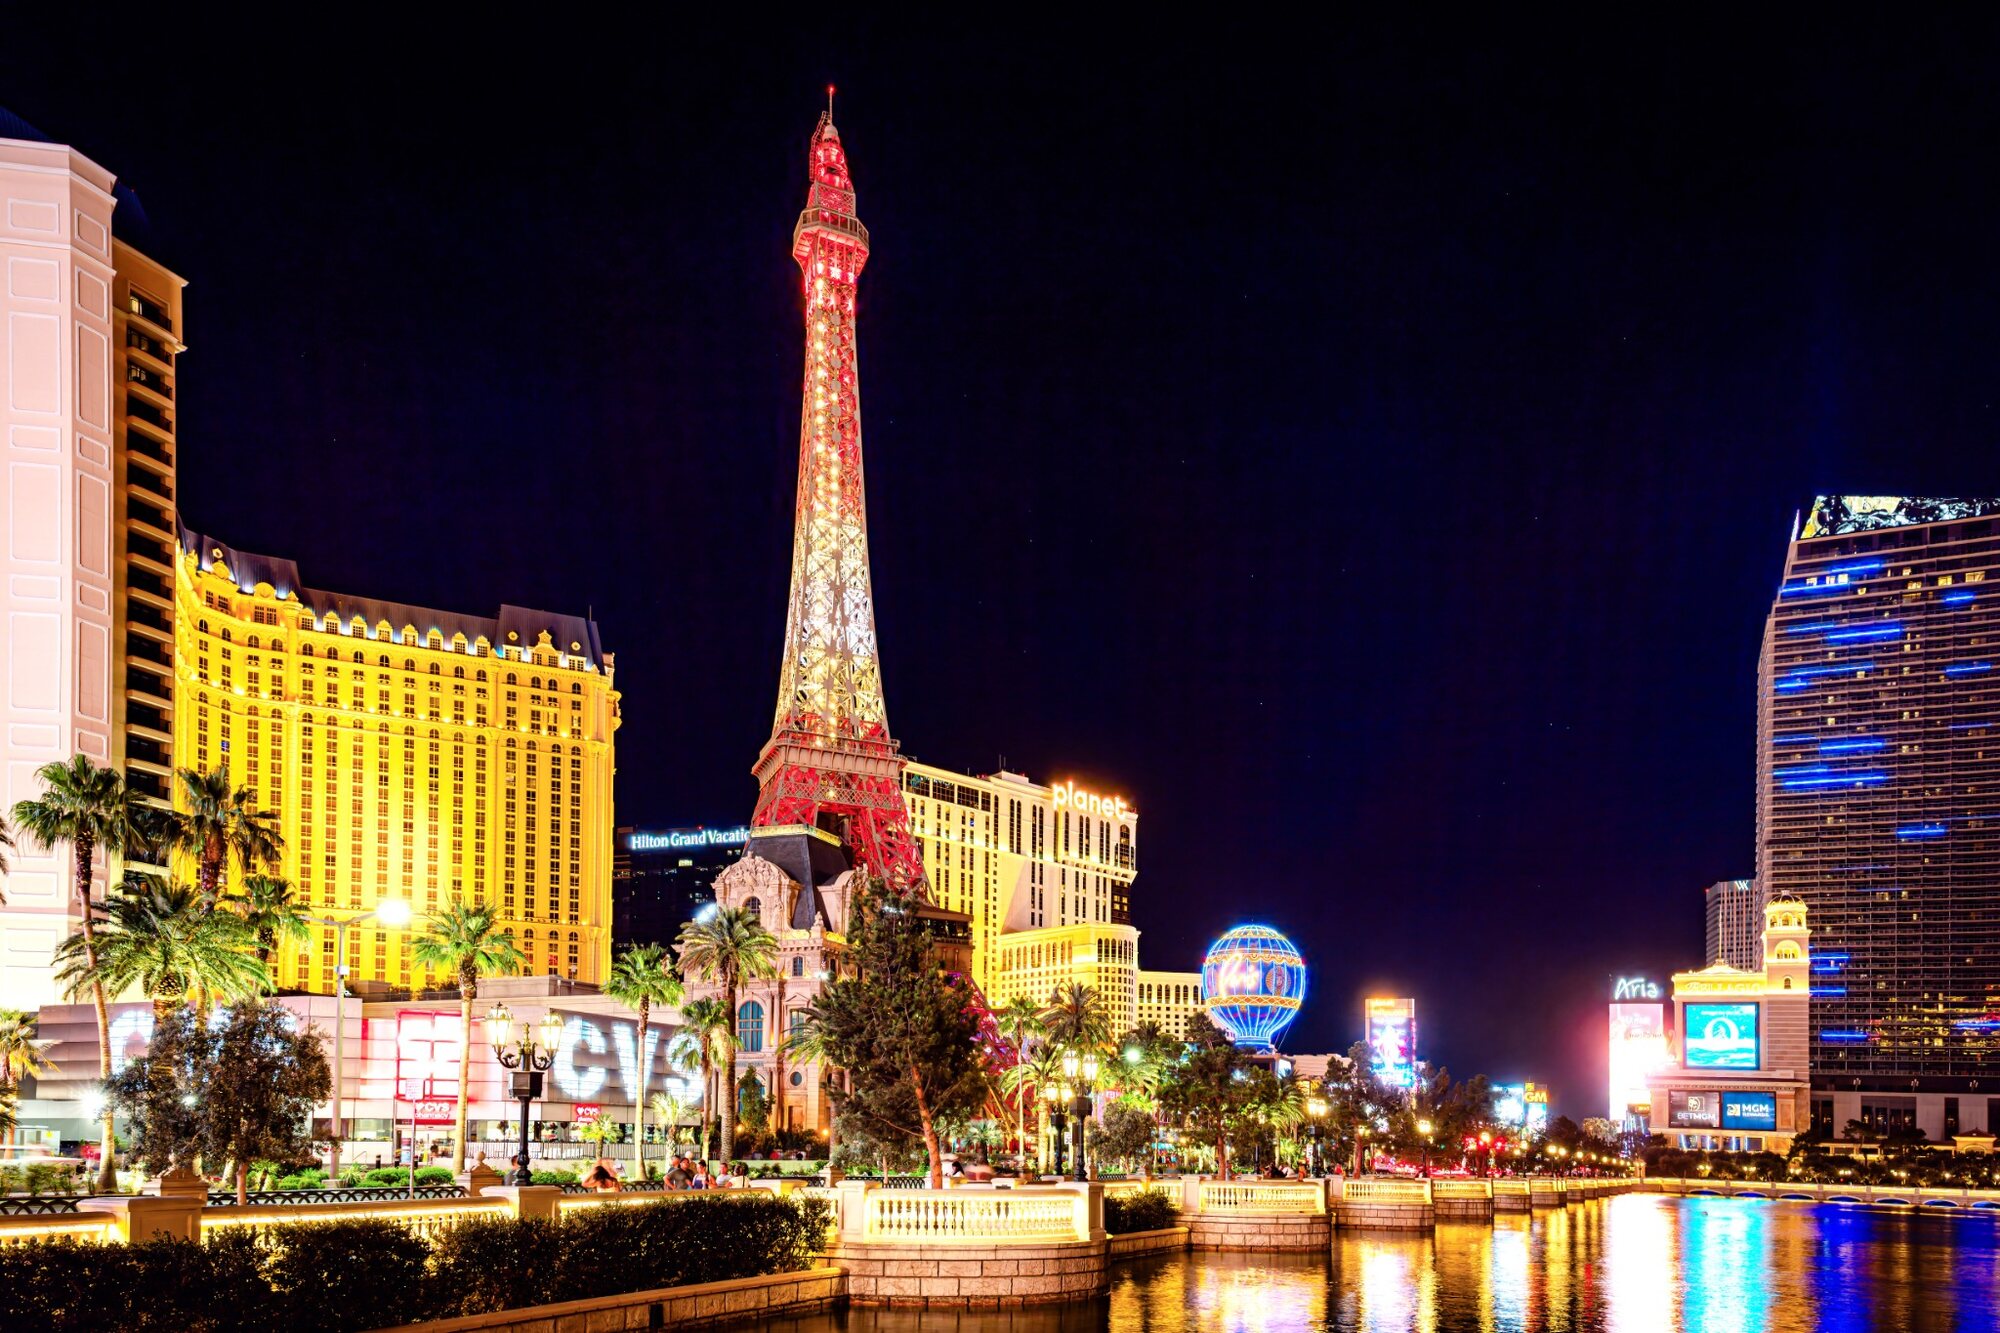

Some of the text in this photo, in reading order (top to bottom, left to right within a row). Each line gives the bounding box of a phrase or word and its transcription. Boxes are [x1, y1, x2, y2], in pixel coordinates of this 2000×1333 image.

[1053, 781, 1127, 820] planet
[631, 834, 670, 851] Hilton
[670, 830, 706, 847] Grand
[1614, 976, 1659, 1000] Aria
[553, 1014, 705, 1105] CVS
[425, 1102, 451, 1113] CVS
[583, 1106, 600, 1116] CVS
[1742, 1104, 1769, 1112] MGM
[1677, 1112, 1716, 1120] BETMGM
